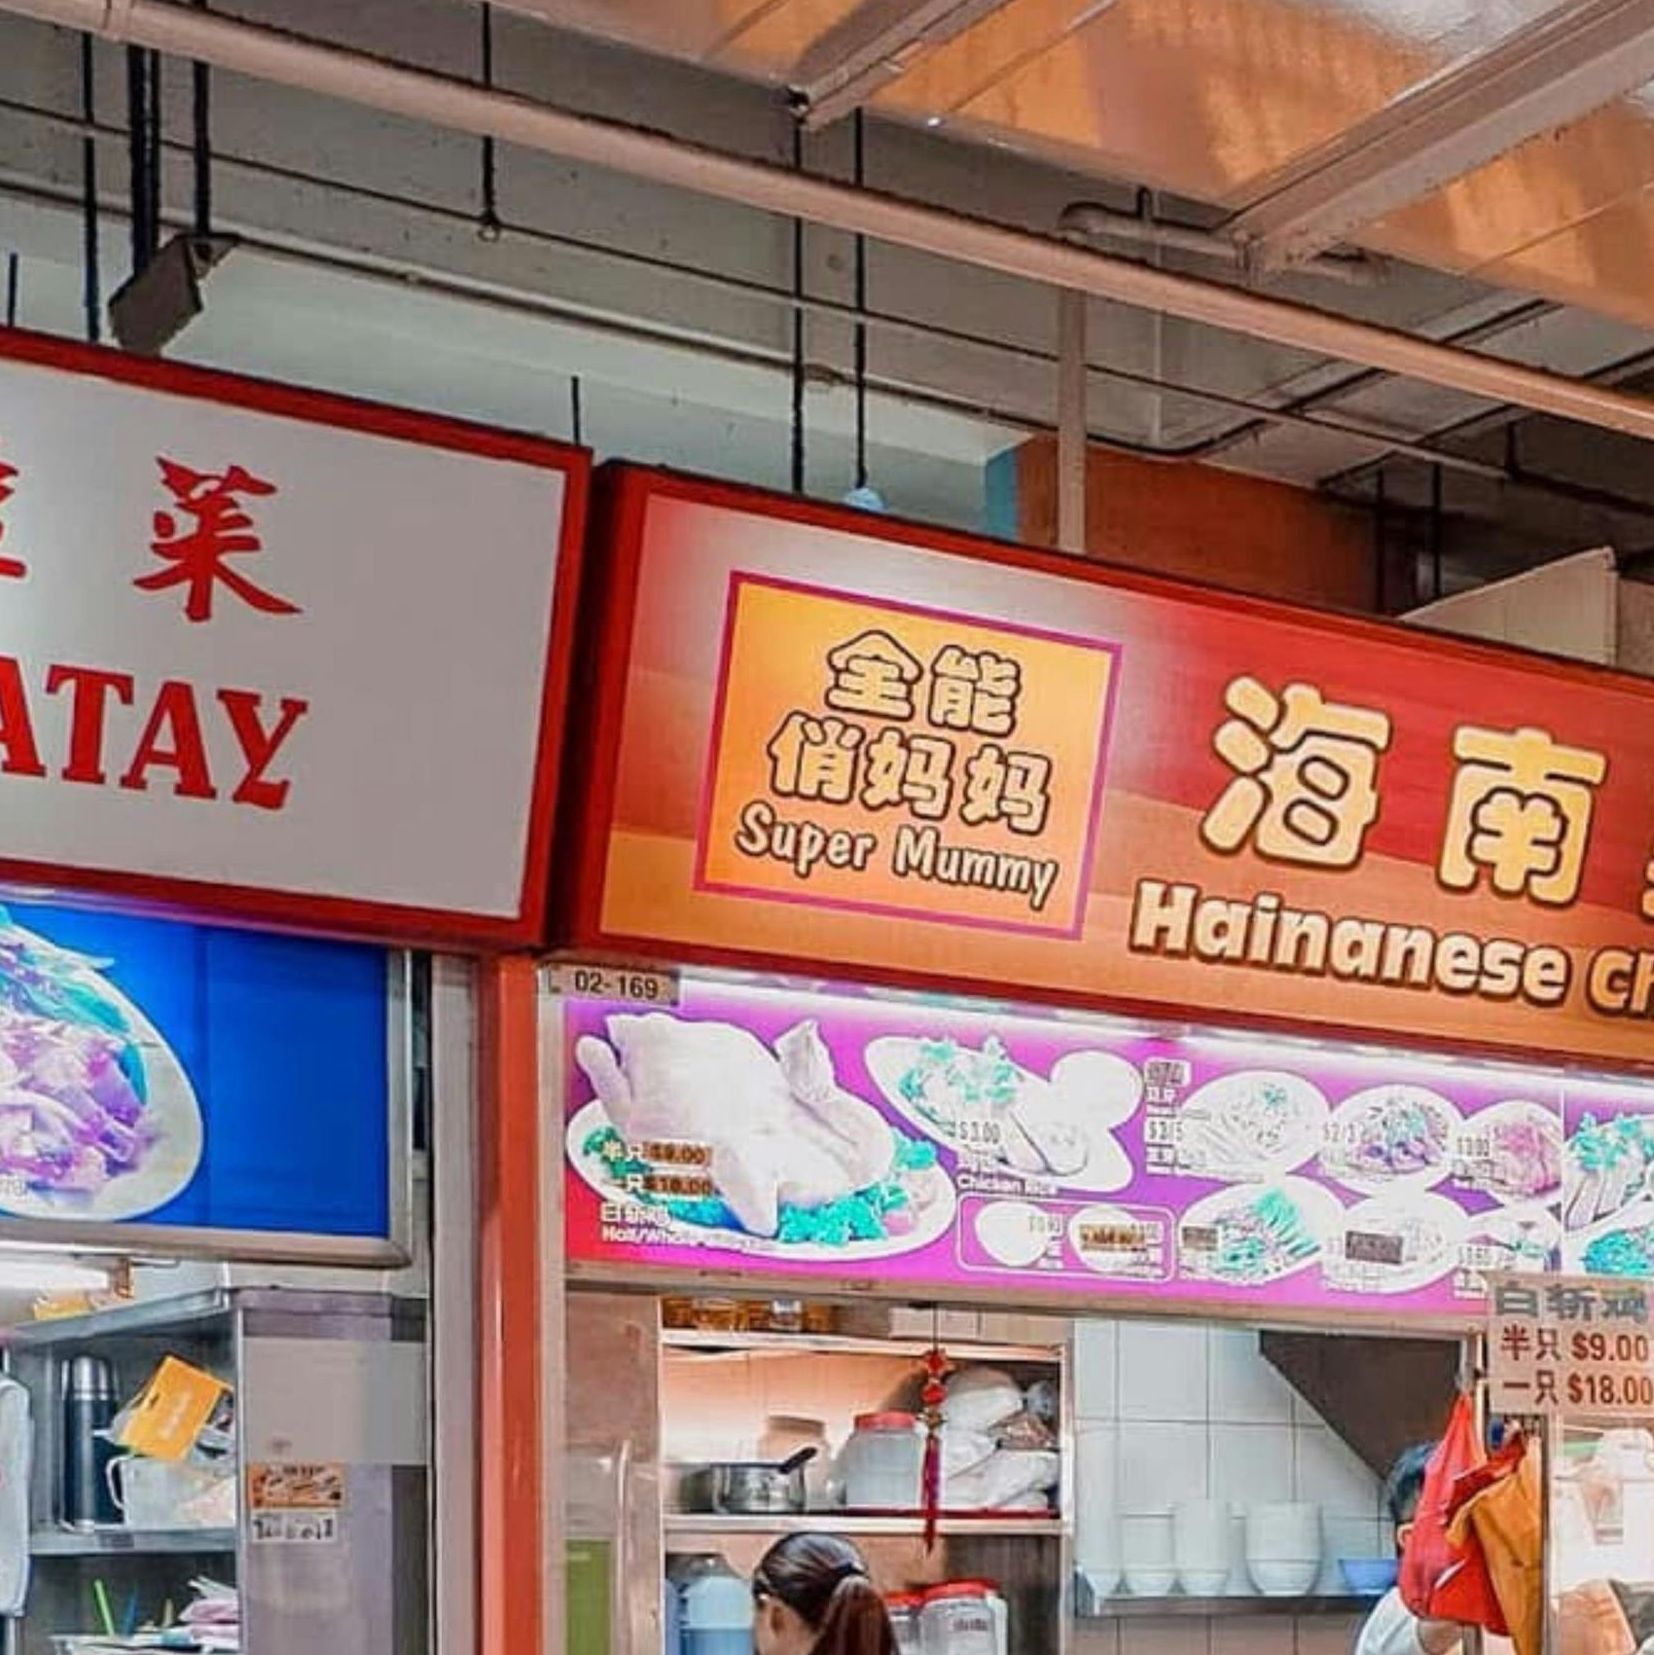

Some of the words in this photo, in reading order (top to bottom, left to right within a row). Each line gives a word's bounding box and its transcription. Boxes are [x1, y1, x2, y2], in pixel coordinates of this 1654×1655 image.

[0, 455, 304, 622] 菜
[825, 630, 1021, 736] 全能
[767, 710, 1052, 834] 俏妈妈
[736, 801, 876, 878] Super
[893, 825, 1059, 911] Mummy
[574, 970, 659, 999] 02-169
[1130, 881, 1571, 1002] Hainanese
[1502, 1324, 1561, 1360] 半只
[1571, 1331, 1649, 1361] $9.00
[1503, 1370, 1558, 1404] 一只
[1568, 1373, 1654, 1404] $18.00
